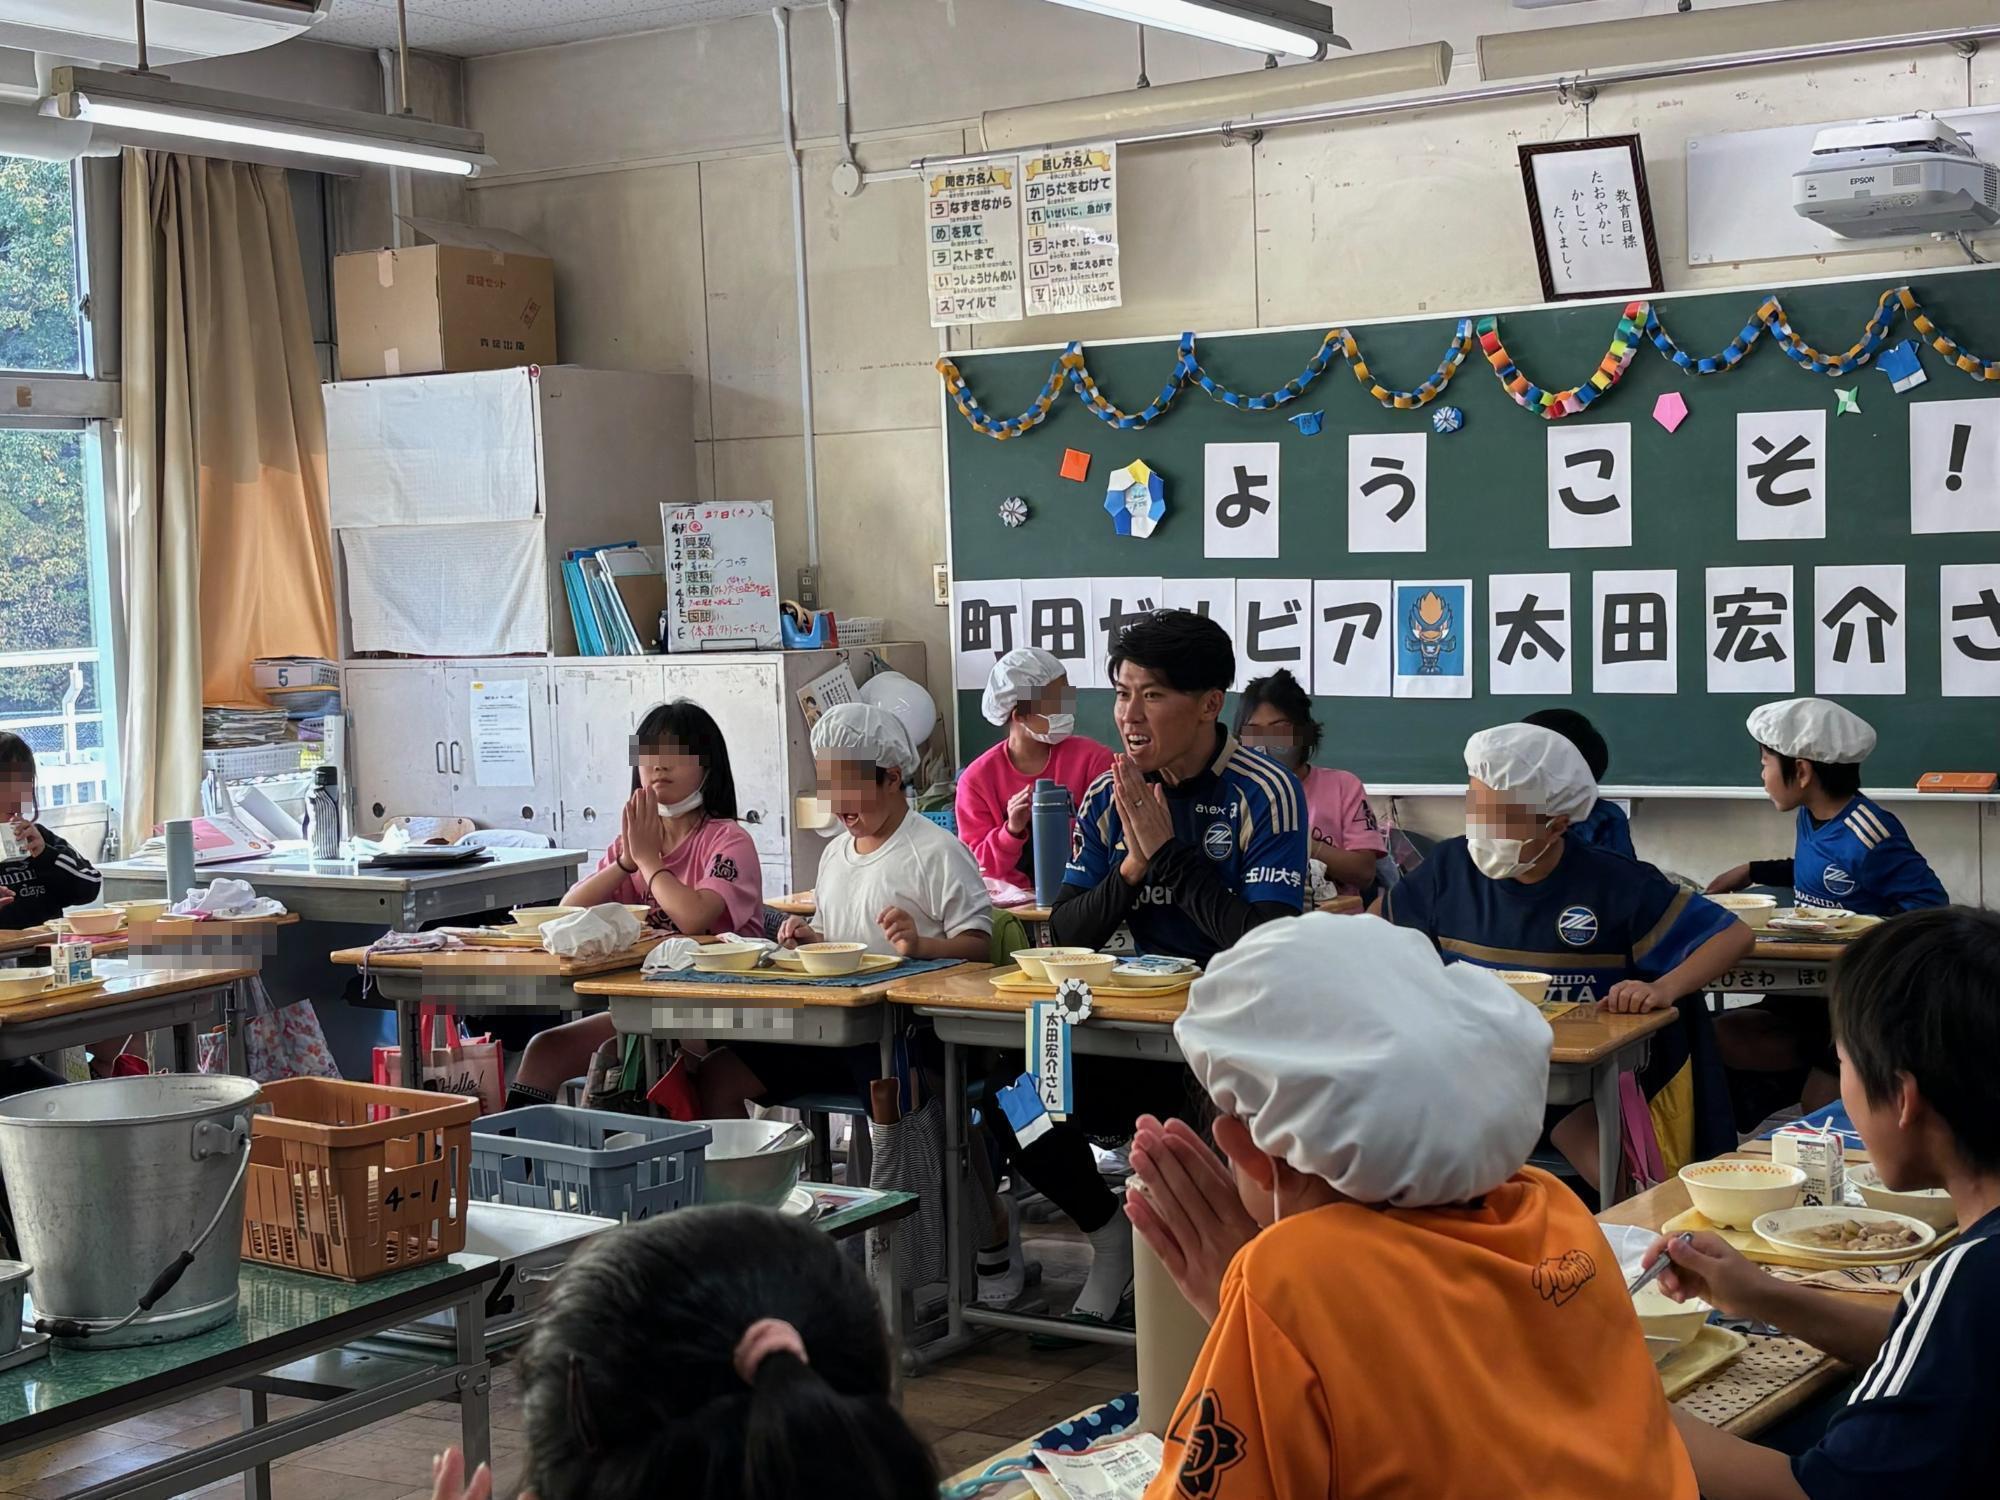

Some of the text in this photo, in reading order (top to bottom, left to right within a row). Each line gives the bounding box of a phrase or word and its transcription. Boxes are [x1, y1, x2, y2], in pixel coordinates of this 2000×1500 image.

[1042, 155, 1093, 171] 話し方名人
[945, 171, 996, 187] 聞き方名人
[1850, 176, 1875, 185] EPSON
[1571, 189, 1588, 248] かしこく
[1592, 170, 1614, 245] たおやかに
[1615, 189, 1638, 249] 教育目標
[1553, 206, 1572, 280] たくましく
[278, 668, 288, 687] 5
[1245, 866, 1301, 888] 玉川大学
[1045, 1012, 1059, 1104] 太田宏介さん
[439, 1070, 485, 1093] Hello!
[384, 1179, 439, 1212] 4-1
